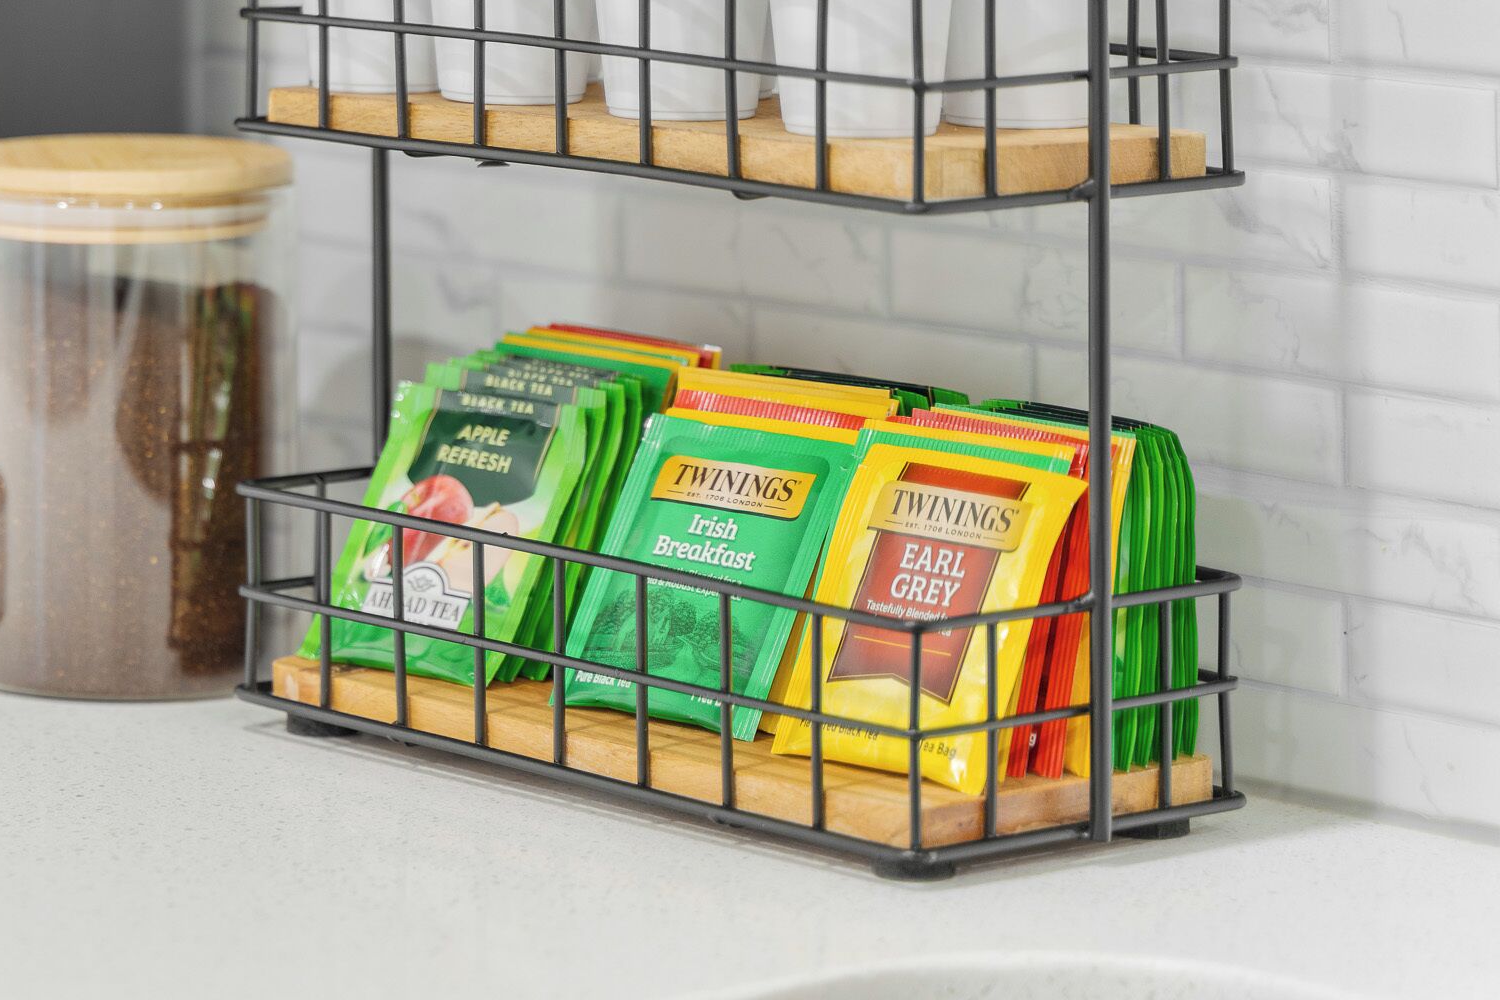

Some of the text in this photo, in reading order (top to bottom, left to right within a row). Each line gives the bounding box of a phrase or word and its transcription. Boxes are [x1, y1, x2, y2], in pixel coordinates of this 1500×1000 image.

[484, 373, 553, 397] BLACK TEA
[461, 393, 535, 415] BLACK TEA
[457, 424, 511, 447] APPLE
[436, 443, 513, 474] REFRESH
[673, 463, 798, 503] TWININGS
[726, 498, 764, 508] LONDON
[891, 489, 1015, 534] TWININGS
[687, 514, 739, 541] Irish
[945, 528, 982, 540] LONDON
[652, 534, 757, 571] Breakfast
[899, 543, 966, 579] EARL
[890, 573, 961, 608] GREY
[367, 591, 427, 614] AHAD
[430, 600, 460, 622] TEA
[866, 599, 906, 619] Tastefully
[936, 742, 956, 760] Bag
